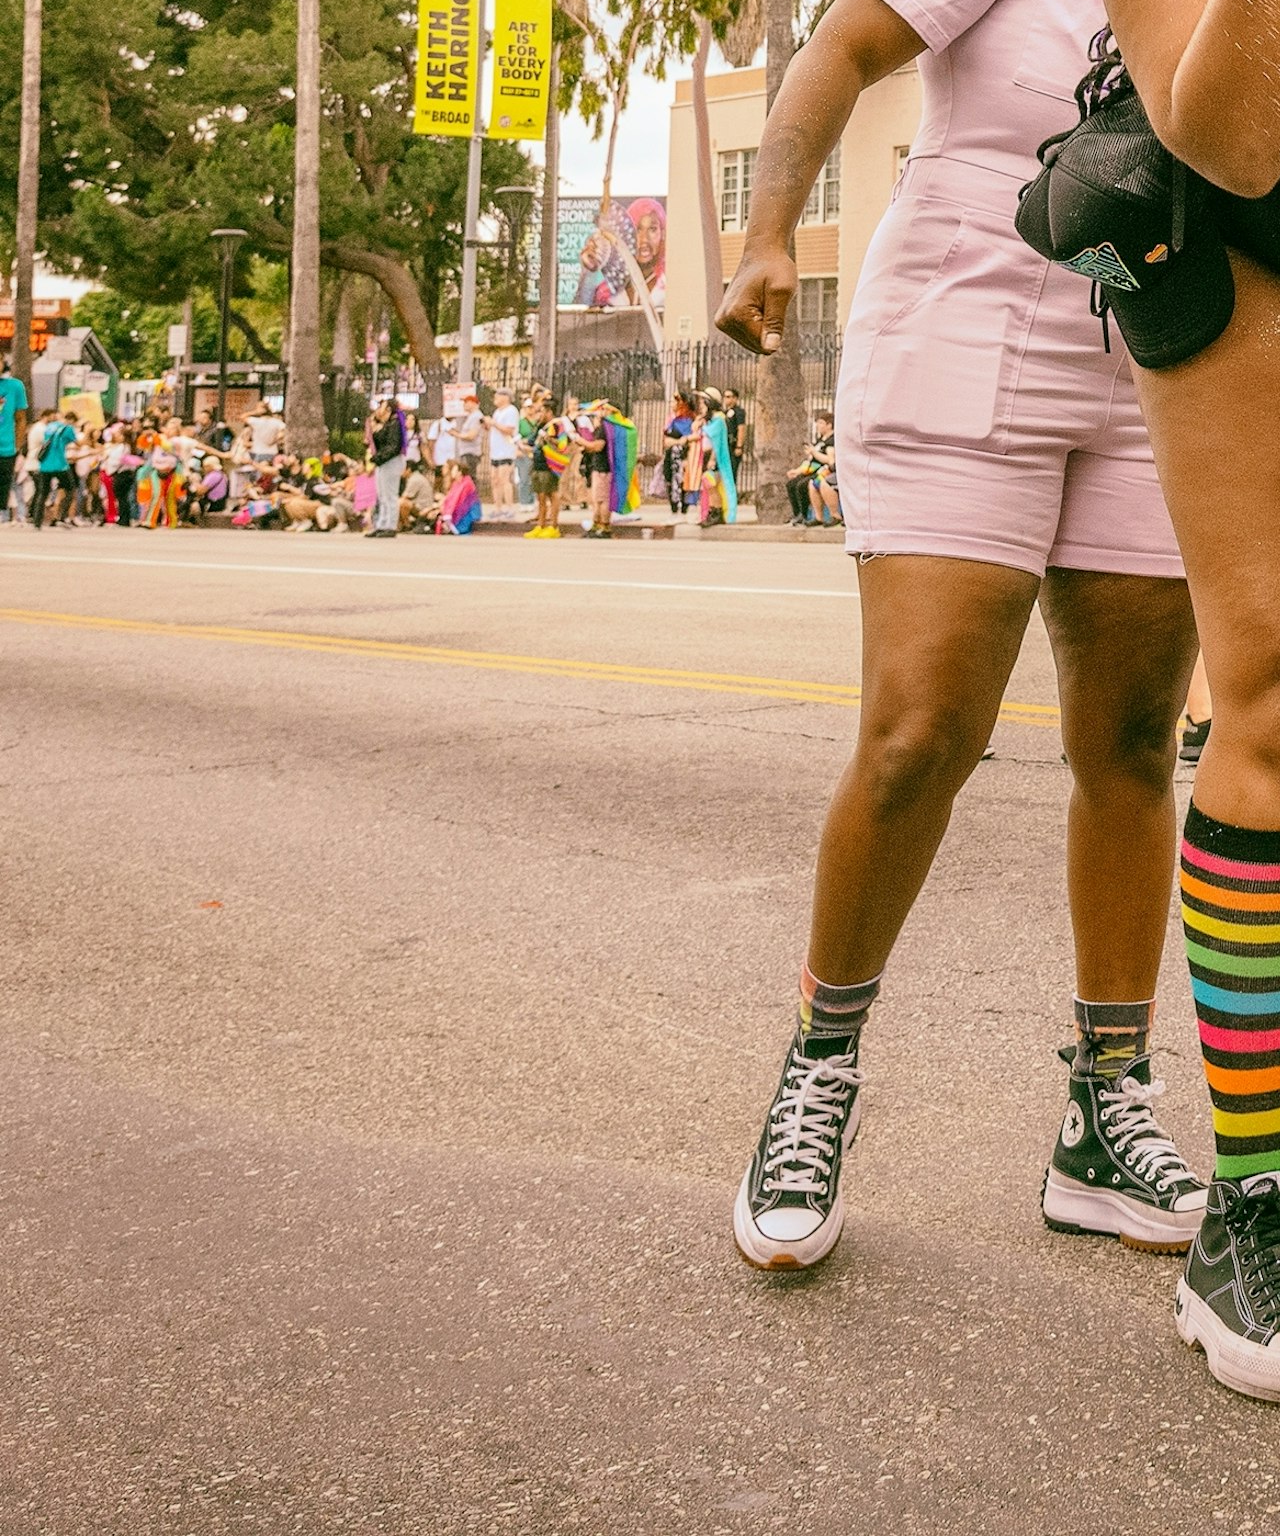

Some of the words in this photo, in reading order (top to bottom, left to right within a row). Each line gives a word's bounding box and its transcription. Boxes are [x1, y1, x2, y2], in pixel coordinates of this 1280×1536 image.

[508, 21, 538, 34] ART
[516, 34, 529, 45] IS
[425, 11, 448, 100] KEITH
[507, 45, 537, 57] FOR
[498, 56, 546, 70] EVERY
[501, 68, 543, 82] BODY
[431, 111, 471, 125] BROAD
